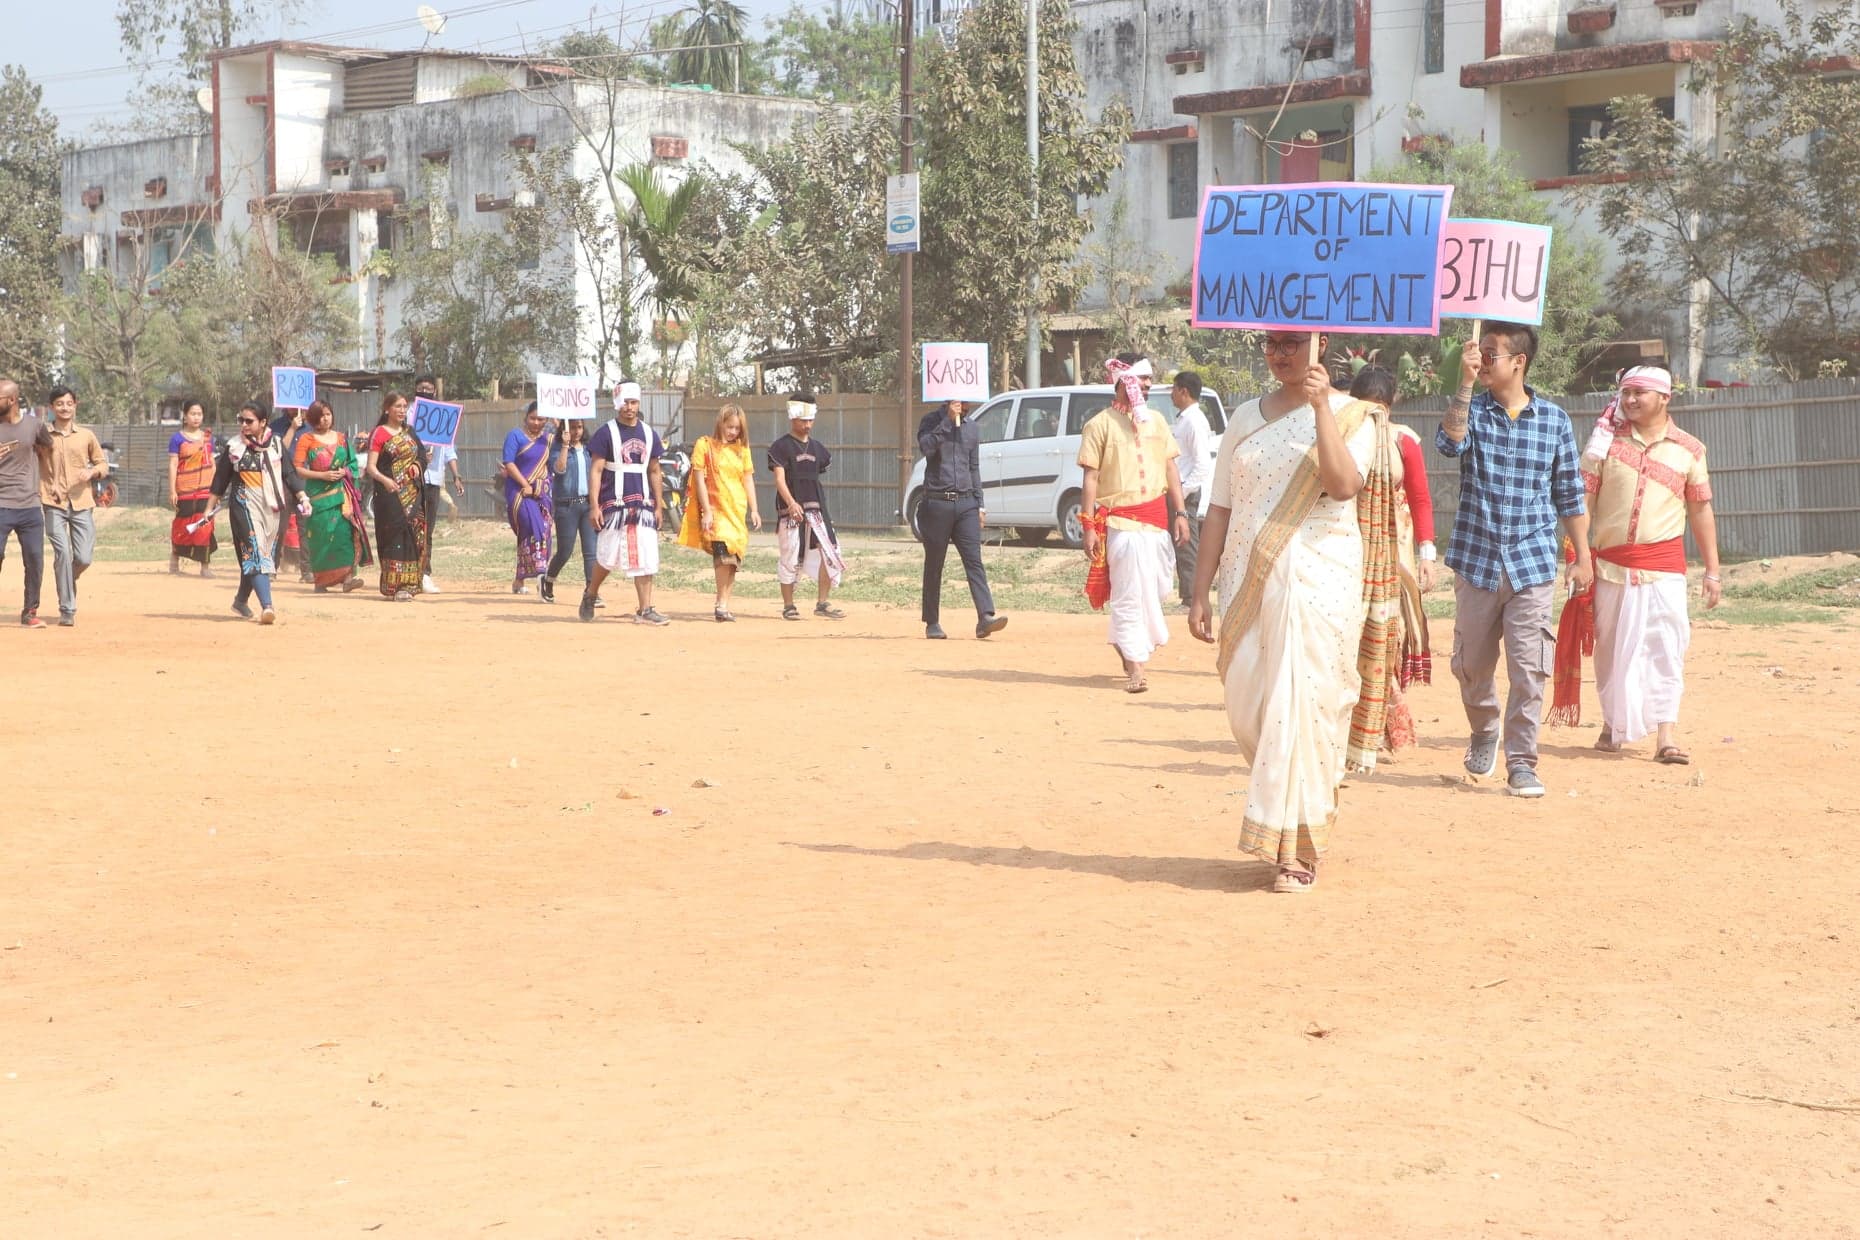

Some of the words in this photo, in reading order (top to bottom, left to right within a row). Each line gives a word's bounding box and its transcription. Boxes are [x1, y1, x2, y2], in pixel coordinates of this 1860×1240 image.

[1204, 191, 1444, 236] DEPARTMENT
[1314, 238, 1350, 262] OF
[1440, 237, 1545, 303] BIHU
[1198, 272, 1427, 323] MANAGEMENT
[926, 358, 979, 386] KARBI
[540, 386, 590, 408] MISING
[415, 403, 459, 437] BODO
